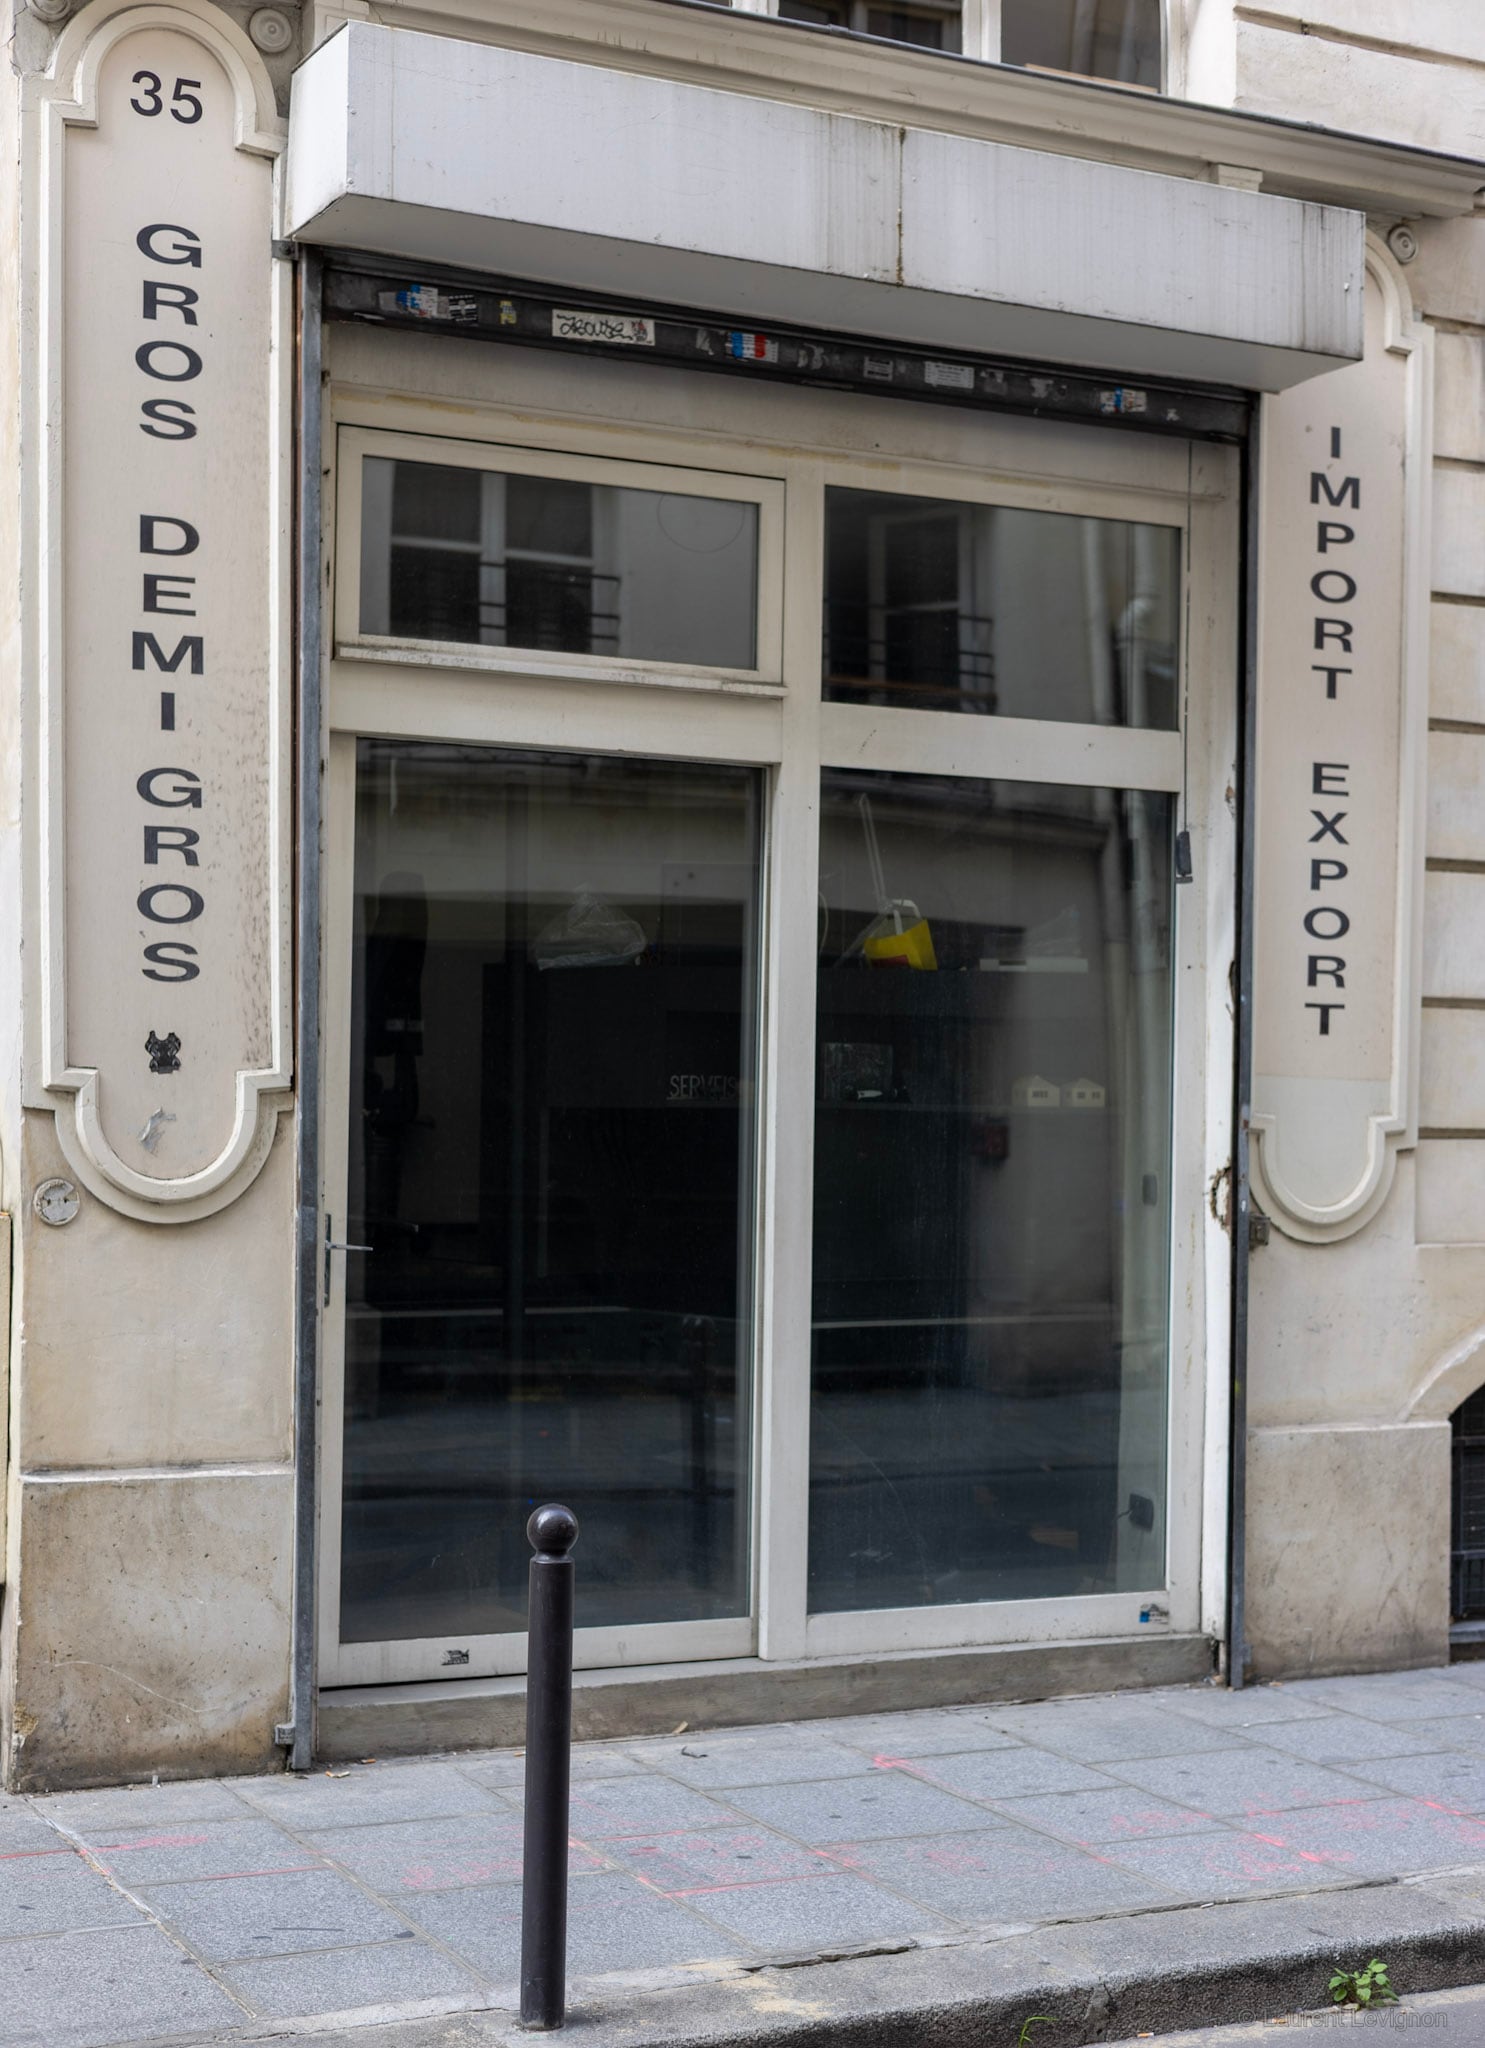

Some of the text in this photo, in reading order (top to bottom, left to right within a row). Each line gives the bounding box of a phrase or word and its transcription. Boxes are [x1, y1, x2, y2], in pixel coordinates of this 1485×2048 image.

[130, 70, 203, 125] 35
[132, 223, 205, 983] GROS DEMI GROS
[1303, 426, 1361, 1036] IMPORT EXPORT
